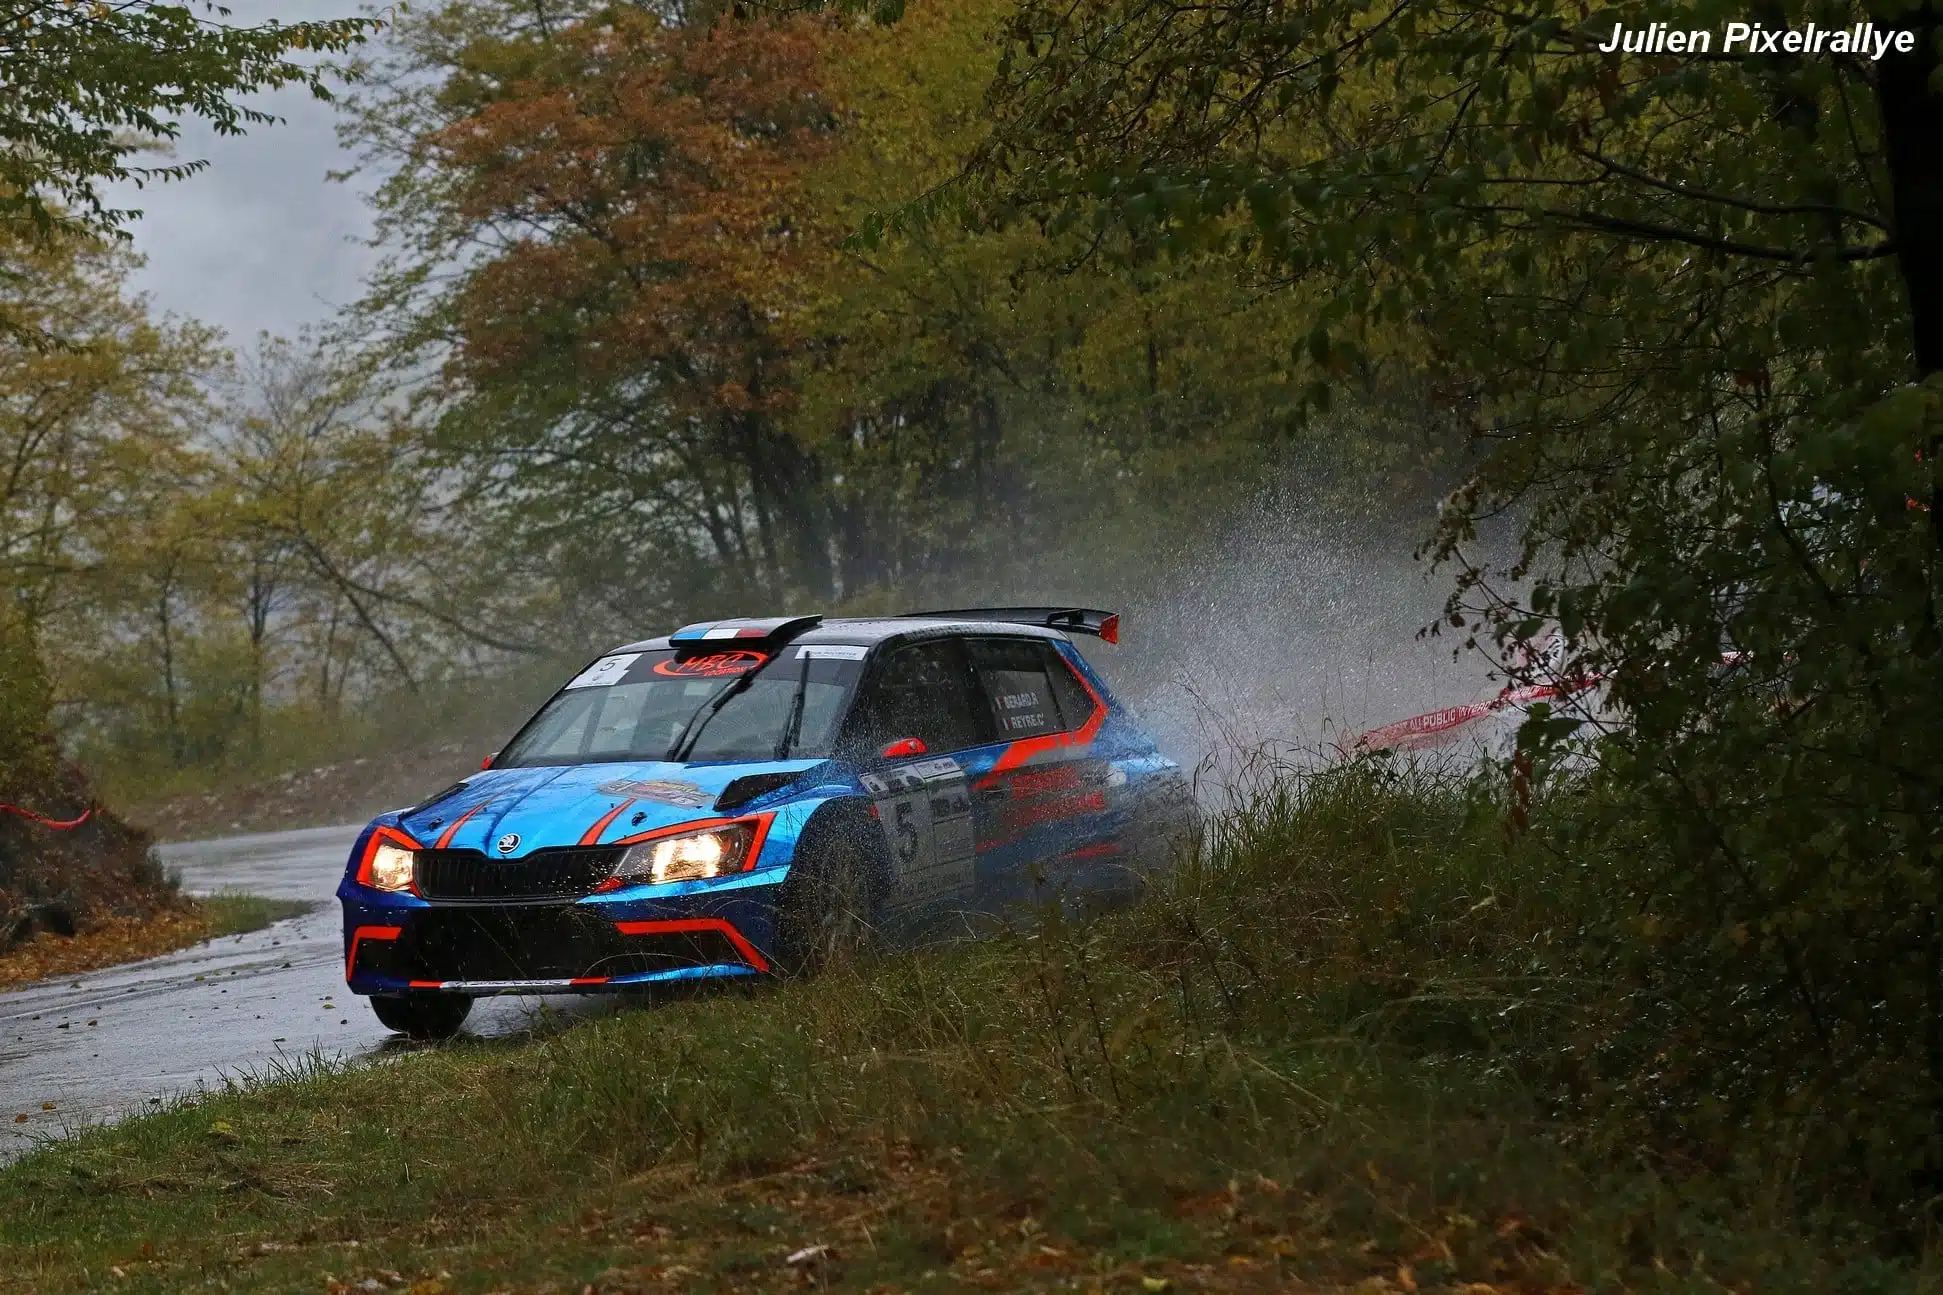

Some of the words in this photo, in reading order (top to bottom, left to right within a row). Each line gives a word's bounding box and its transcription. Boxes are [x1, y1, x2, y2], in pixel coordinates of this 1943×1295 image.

[599, 658, 622, 671] 5
[1423, 709, 1456, 729] PUBLIC
[1457, 702, 1492, 717] INTERD
[896, 801, 919, 864] 5
